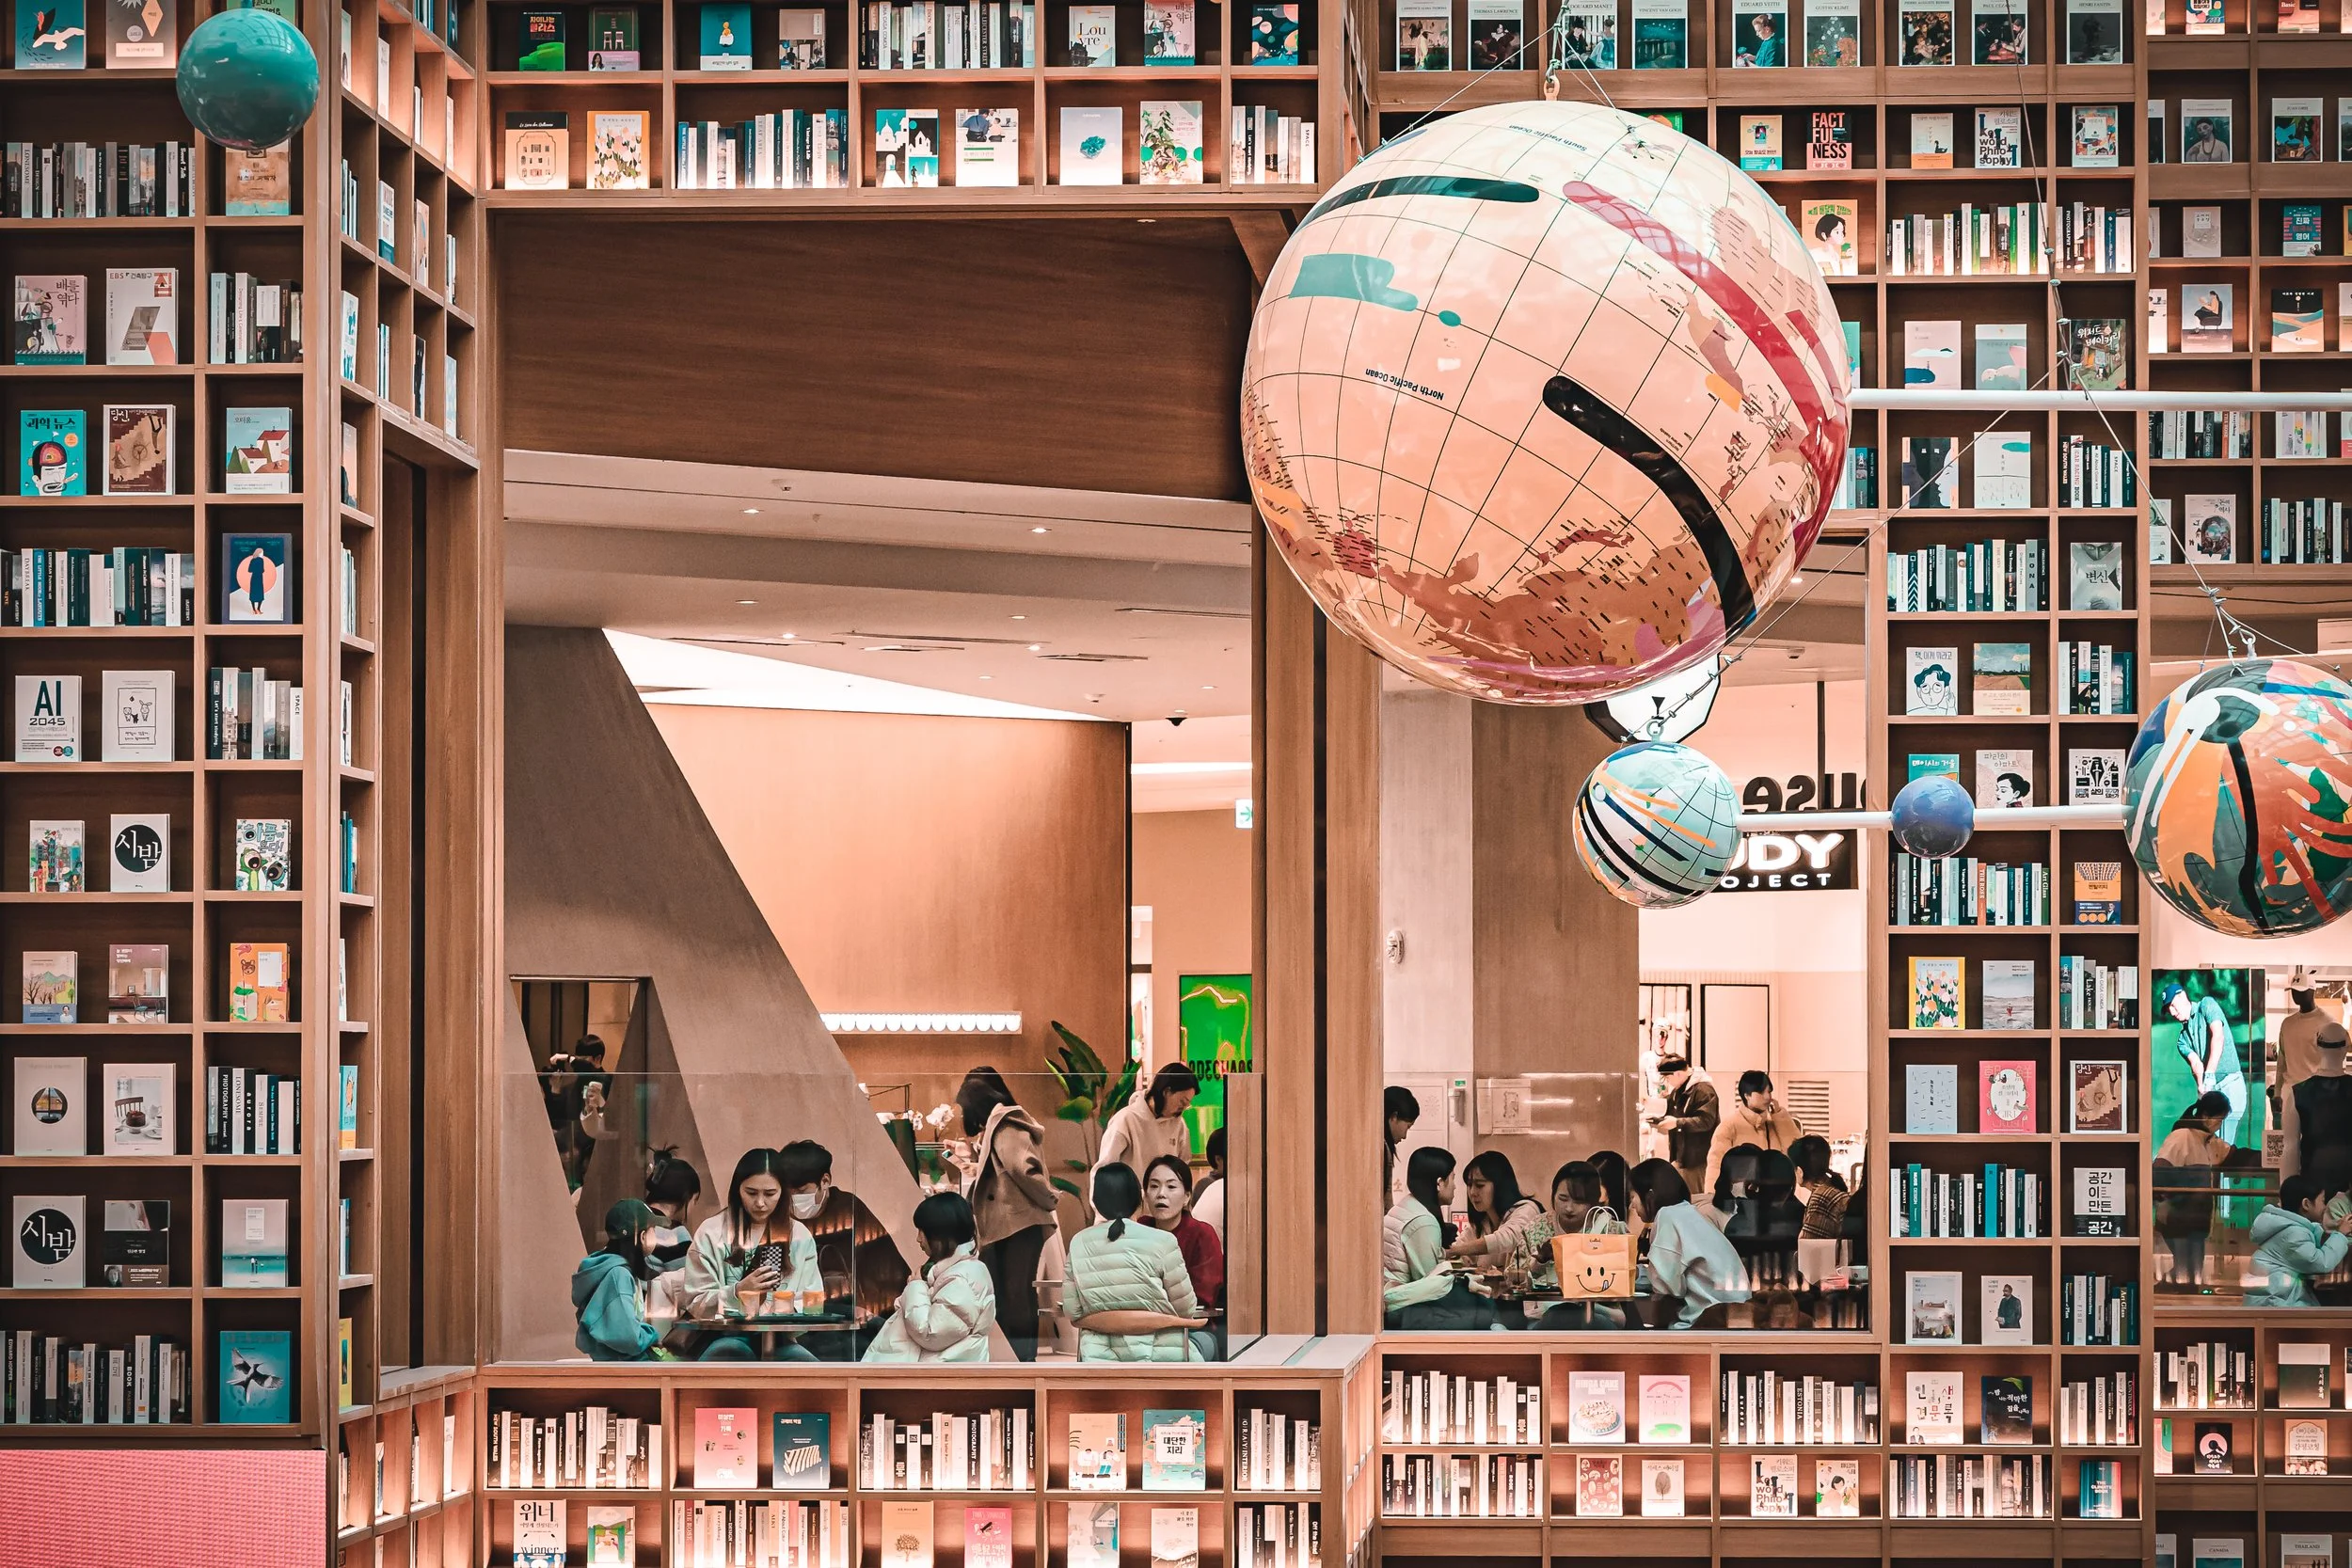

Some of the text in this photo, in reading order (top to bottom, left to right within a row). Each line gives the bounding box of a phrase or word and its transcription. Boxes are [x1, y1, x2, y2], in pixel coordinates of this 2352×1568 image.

[1079, 23, 1106, 36] Lou
[1813, 113, 1845, 128] FACT
[1509, 125, 1587, 151] South Pacific Ocean
[1813, 128, 1837, 143] FUL
[1813, 144, 1847, 158] NESS
[2078, 325, 2104, 339] 위저드
[1365, 368, 1444, 401] North Pacific Ocean
[2086, 570, 2109, 584] 변신
[34, 681, 62, 717] AI
[29, 718, 66, 726] 2045
[1721, 873, 1832, 889] OJECT
[2089, 1172, 2112, 1185] 공간
[2089, 1200, 2112, 1213] 만든
[2089, 1221, 2113, 1235] 공간
[1163, 1437, 1186, 1447] 대단한
[1167, 1447, 1183, 1455] 지리
[520, 1502, 556, 1522] 위너
[521, 1544, 559, 1554] winner
